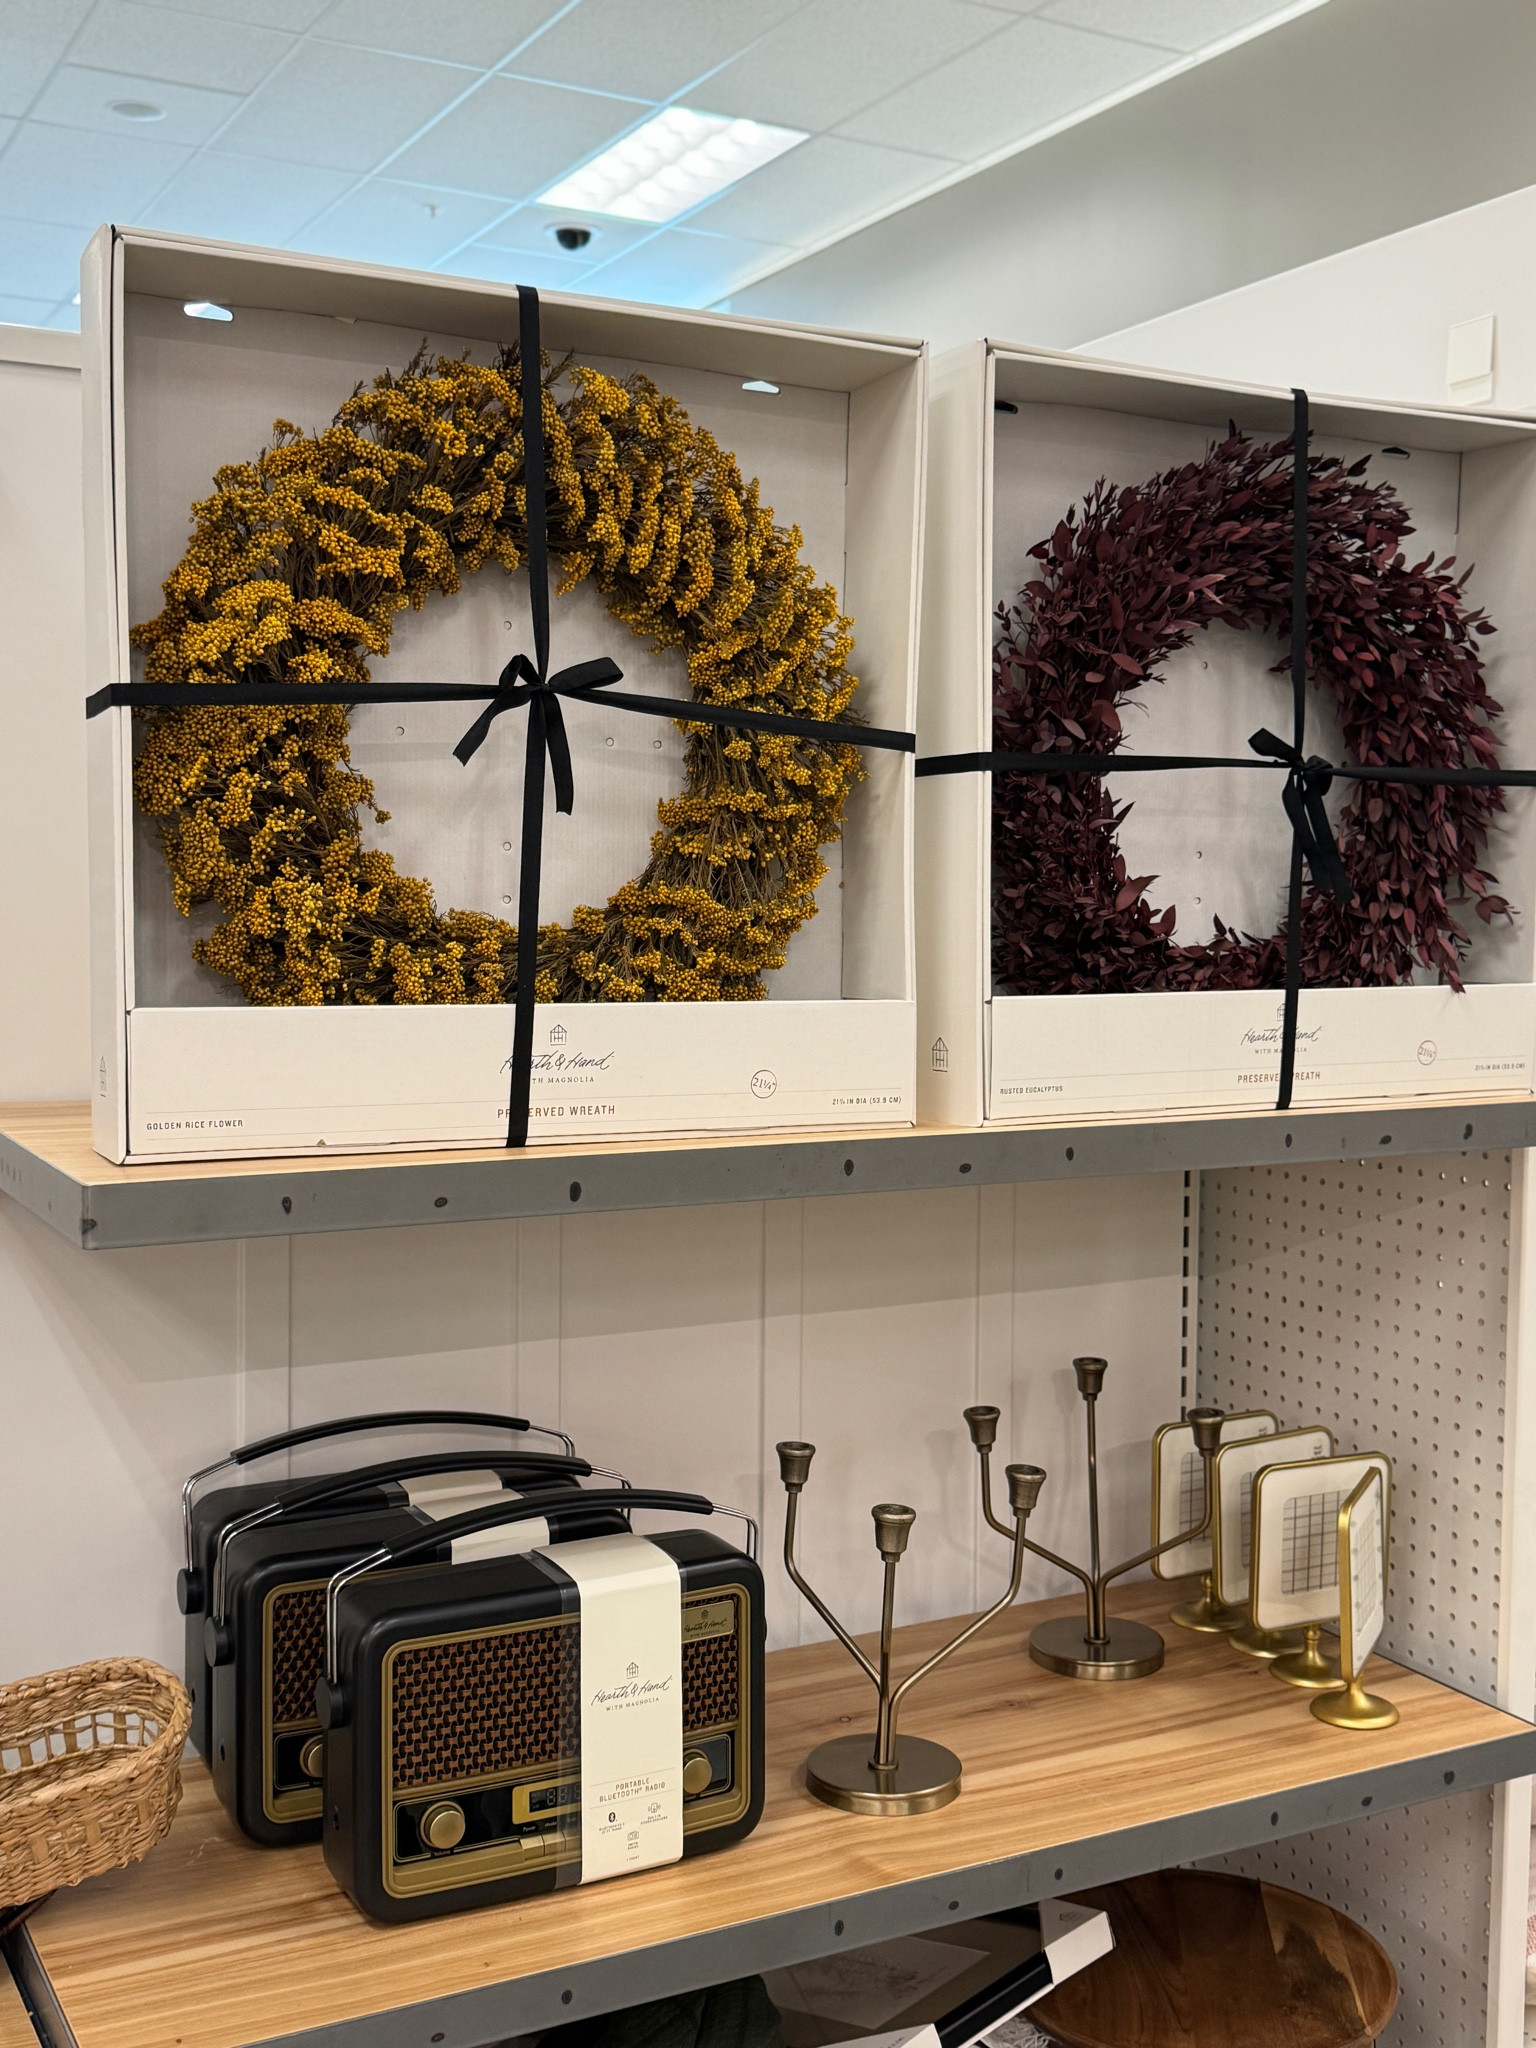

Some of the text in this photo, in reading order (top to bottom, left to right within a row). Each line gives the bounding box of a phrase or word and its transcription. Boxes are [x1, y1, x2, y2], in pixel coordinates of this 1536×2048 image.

[1240, 1026, 1282, 1045] Hearth
[555, 1053, 566, 1071] &
[564, 1051, 615, 1071] Hand
[547, 1076, 595, 1084] MAGNOLIA
[1237, 1071, 1321, 1084] PRESERVE REATH
[1025, 1085, 1064, 1094] EUCALYPTUS
[856, 1097, 867, 1105] DIA
[888, 1095, 902, 1104] CM)
[497, 1104, 616, 1118] PRERVED WREATH
[146, 1120, 243, 1131] GOLDEN RICE FLOWER
[591, 1675, 673, 1707] Hearth & Hand
[606, 1697, 660, 1711] WITH MAGNOLIA
[615, 1777, 650, 1792] PORTABLE
[645, 1781, 666, 1792] RADIO
